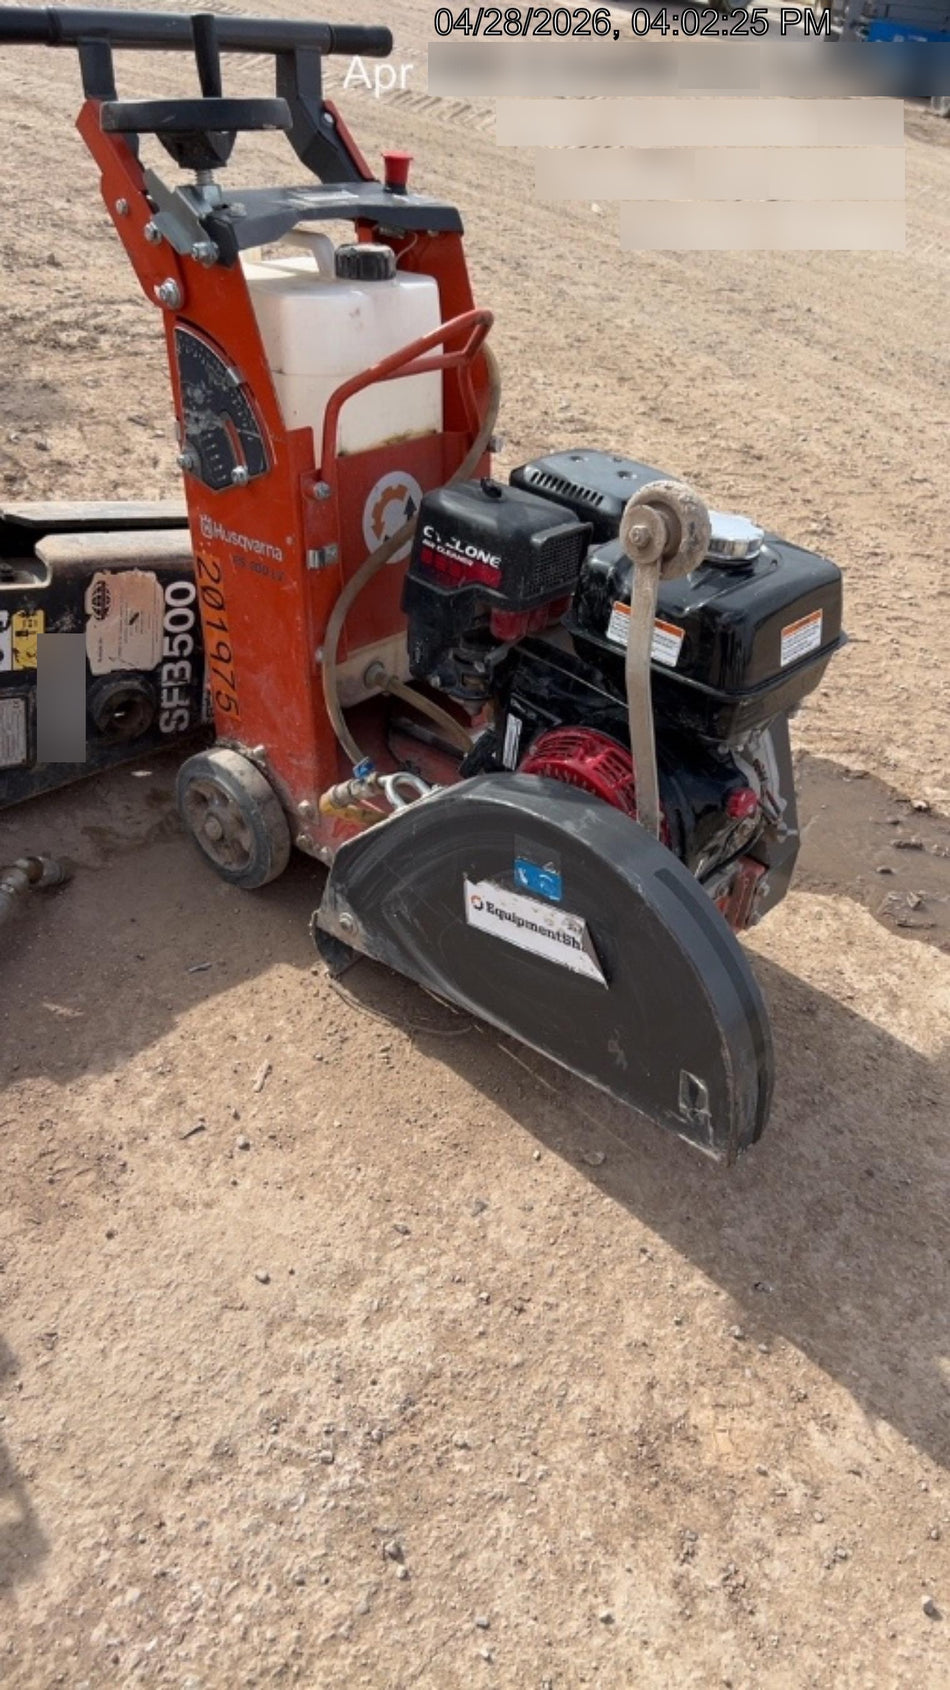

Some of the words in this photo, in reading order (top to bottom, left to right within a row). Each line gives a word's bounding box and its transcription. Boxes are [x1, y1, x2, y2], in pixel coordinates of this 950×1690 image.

[213, 520, 284, 562] Husqvarna
[159, 580, 197, 734] SFB500
[196, 556, 240, 717] 201975
[485, 900, 585, 953] EquipmentSh
